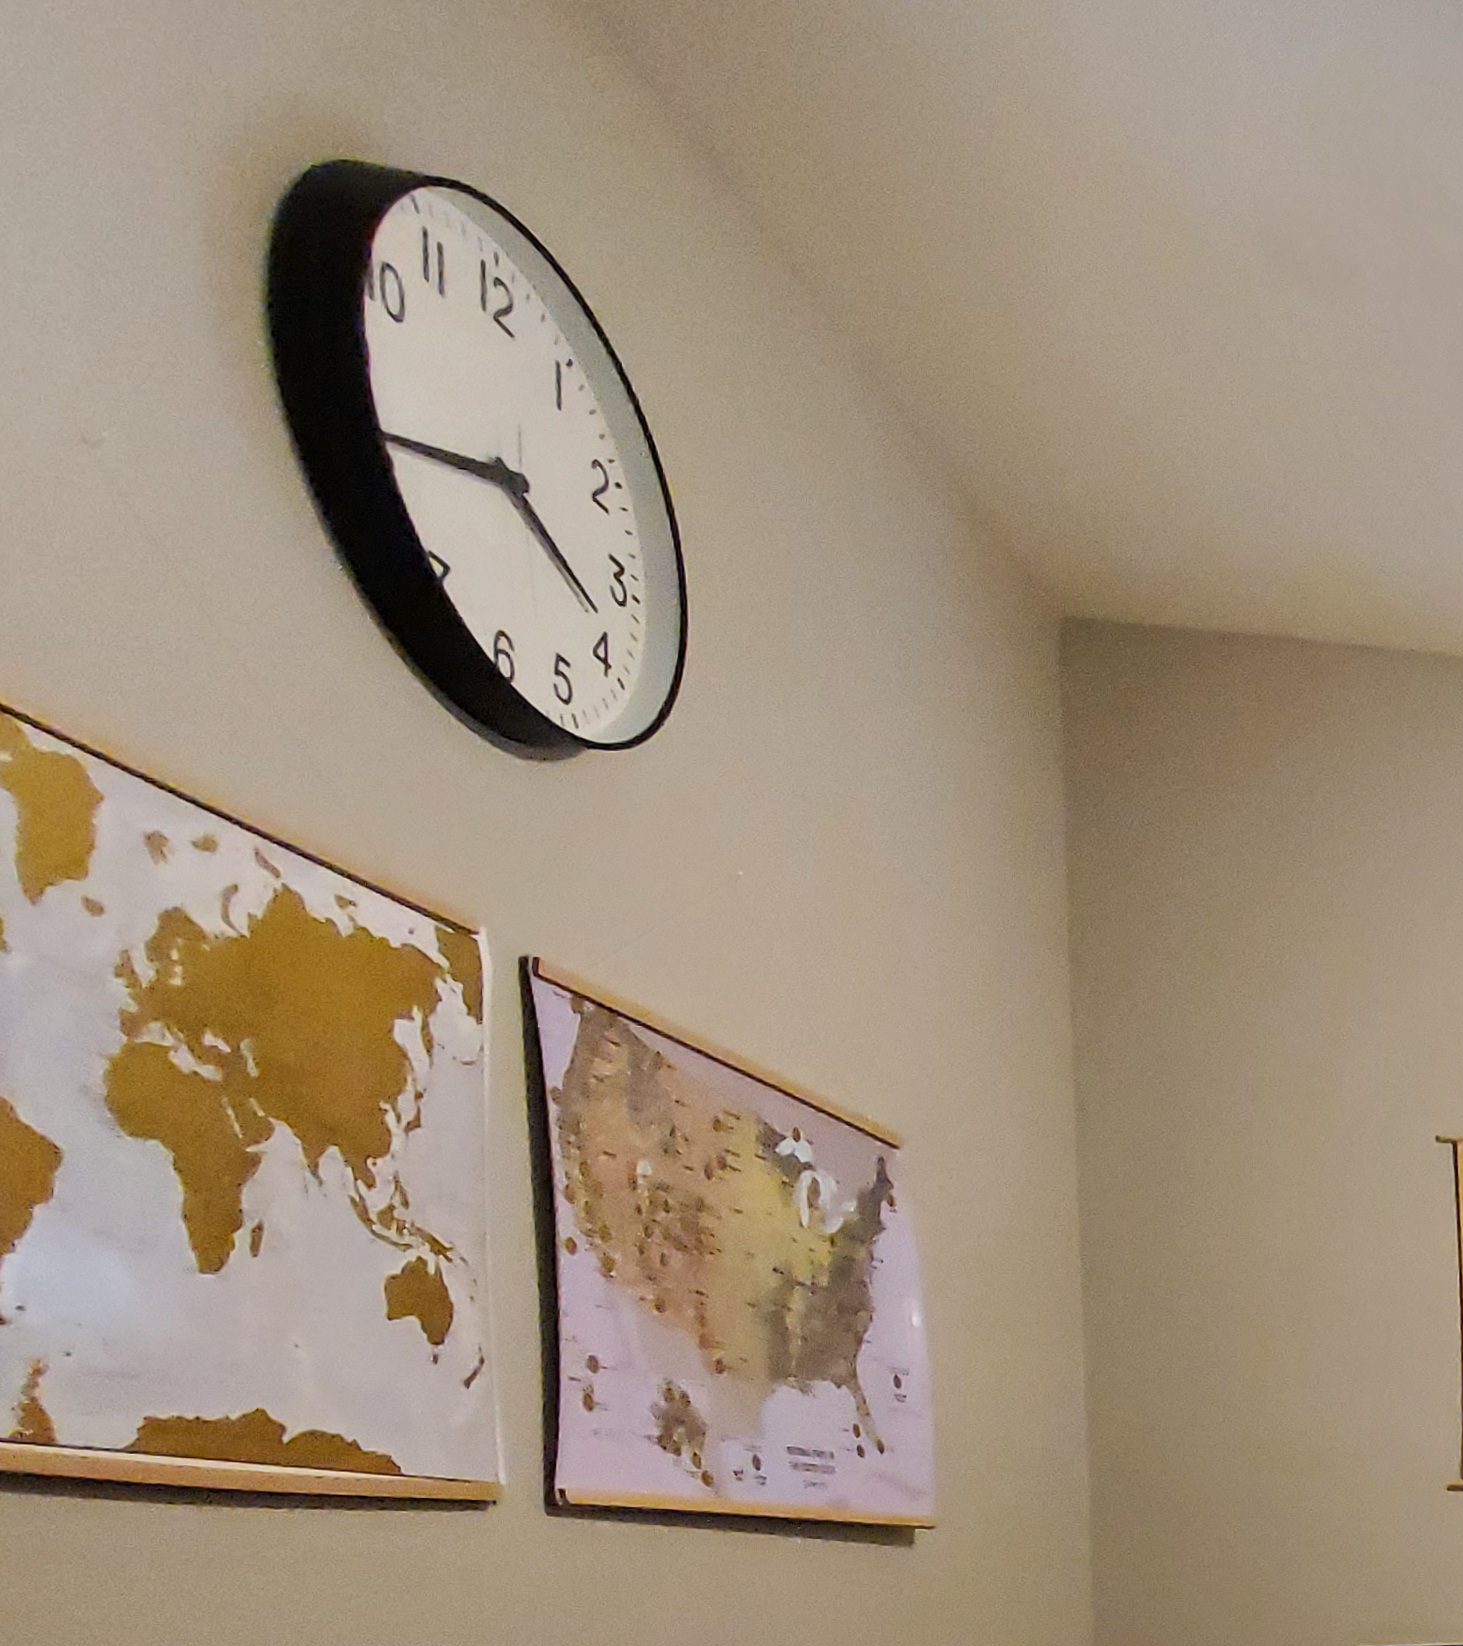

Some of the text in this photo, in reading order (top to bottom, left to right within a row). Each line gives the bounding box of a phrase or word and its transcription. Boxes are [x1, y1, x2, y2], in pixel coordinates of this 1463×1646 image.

[421, 225, 446, 297] 11
[480, 257, 516, 339] 12
[554, 358, 564, 412] 1
[591, 459, 611, 515] 2
[608, 552, 629, 608] 3
[493, 629, 517, 682] 6
[552, 652, 574, 705] 5
[592, 630, 613, 677] 4
